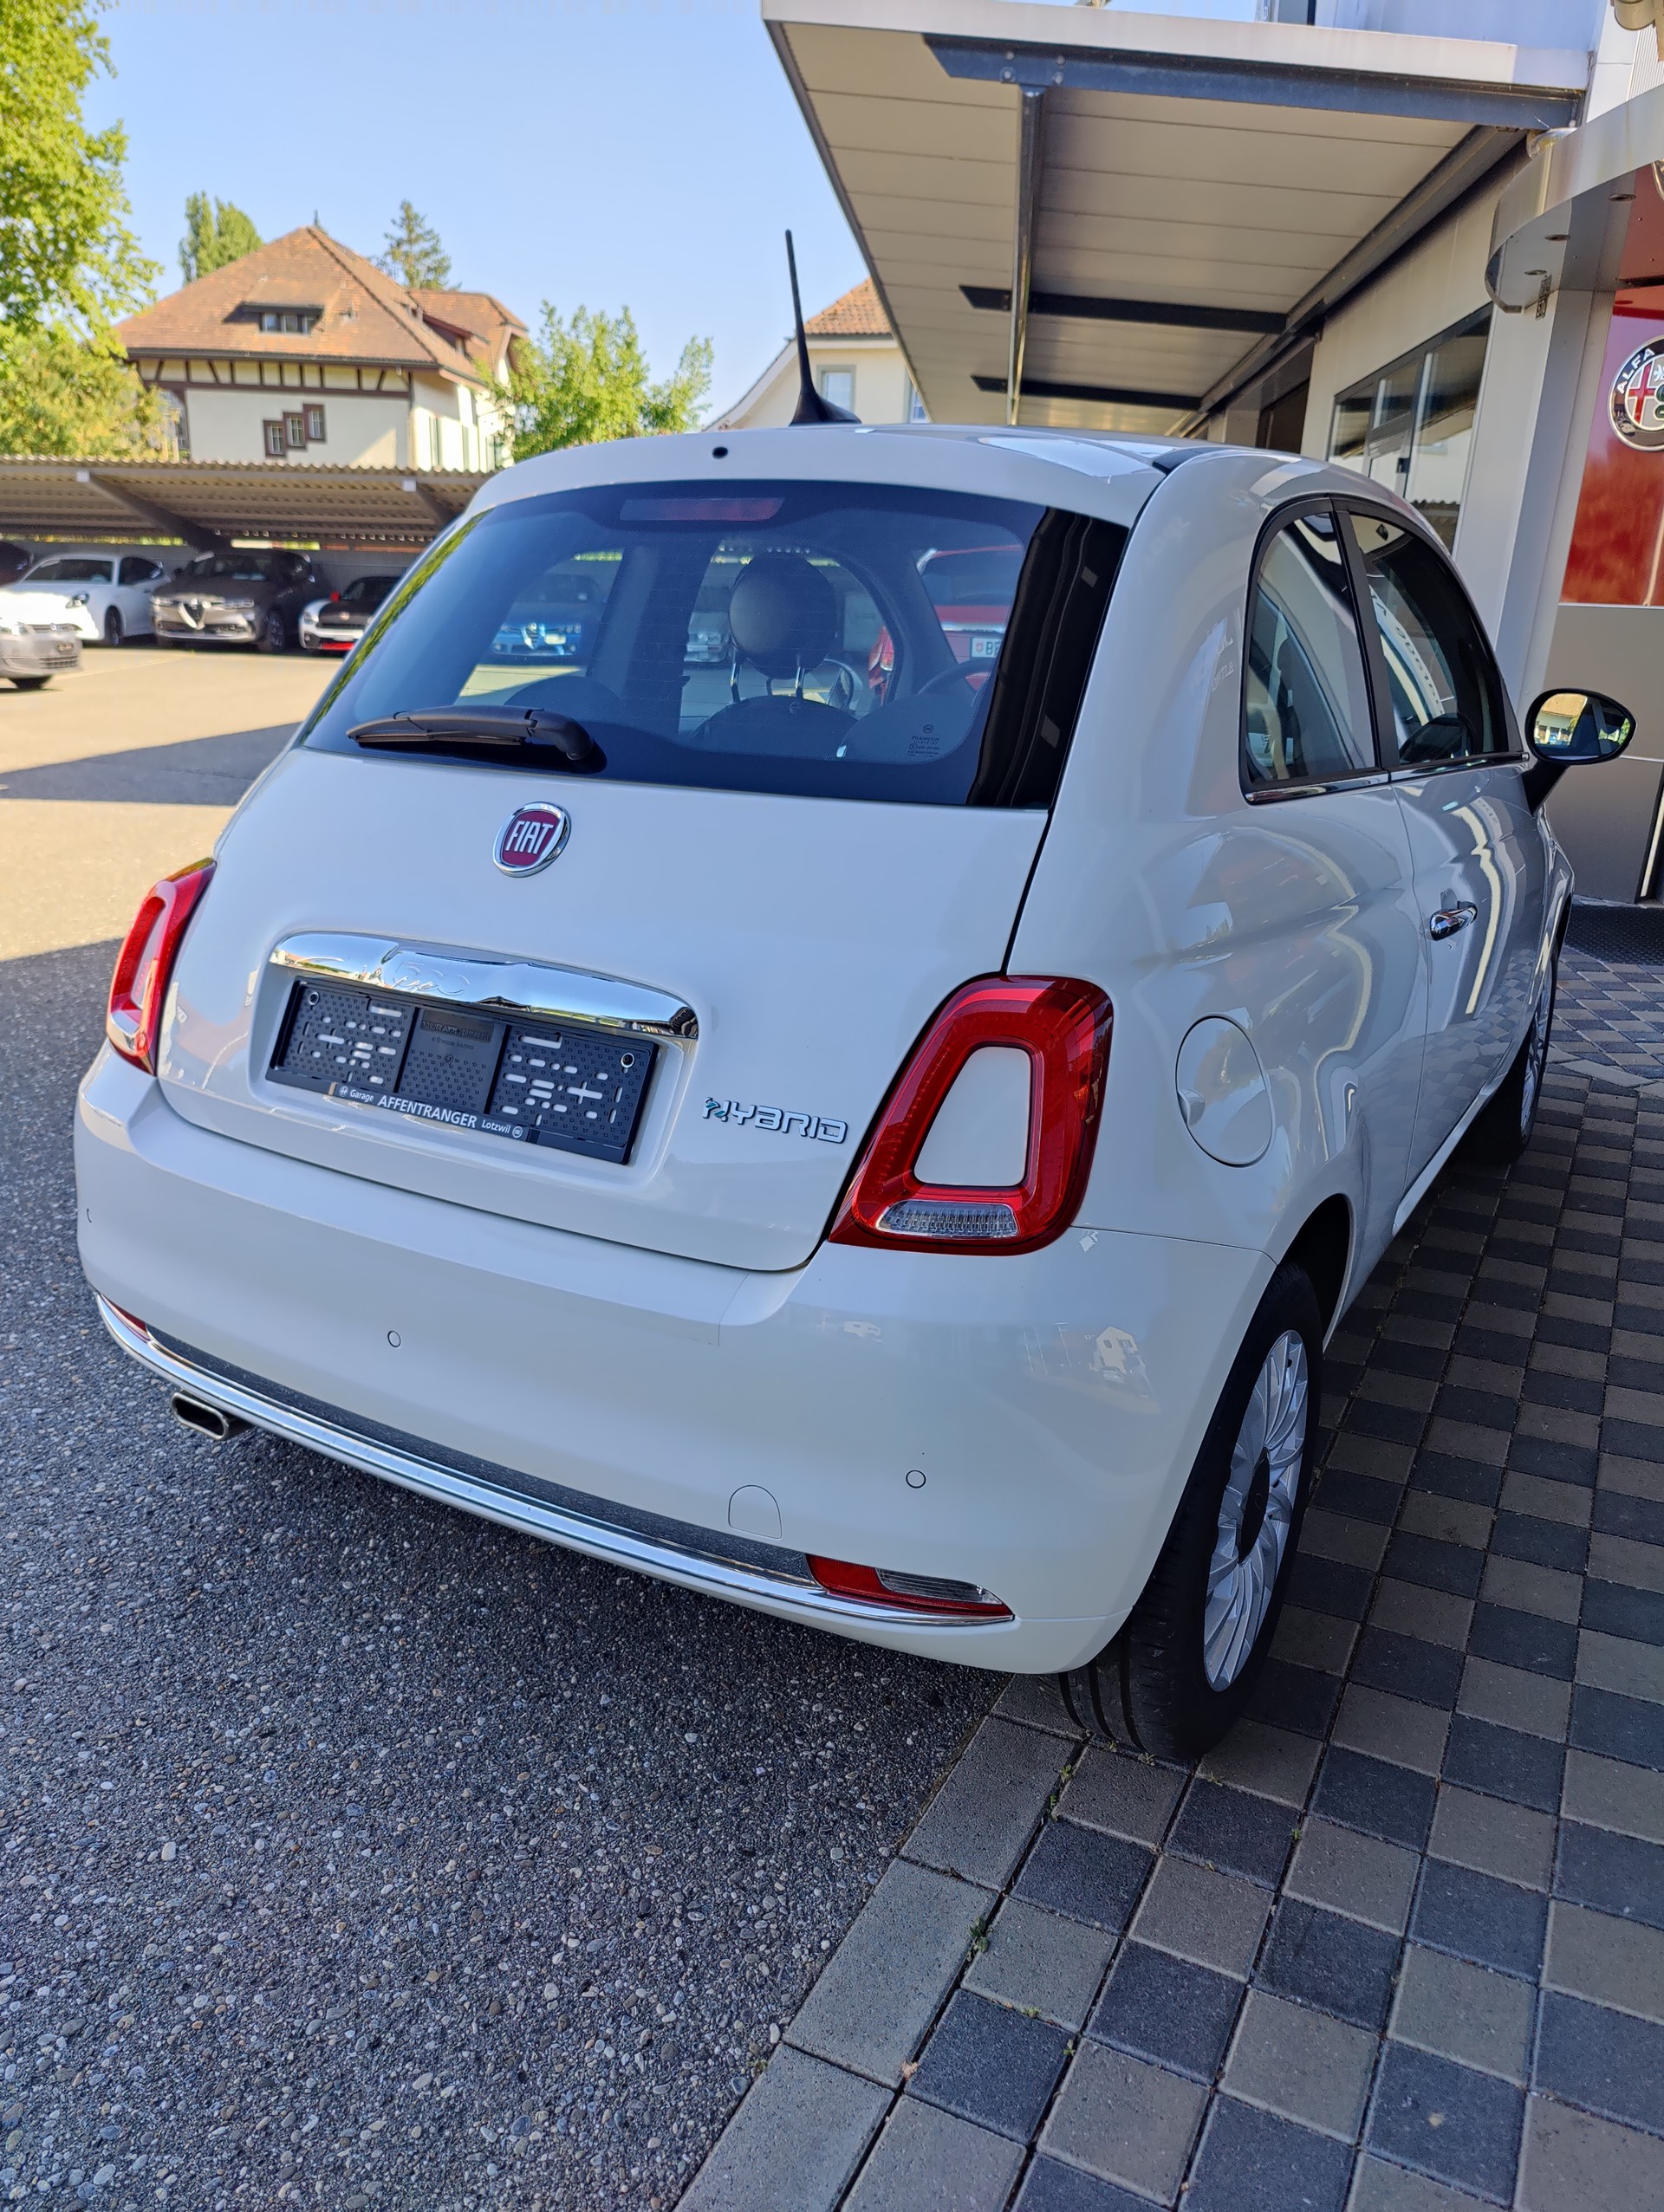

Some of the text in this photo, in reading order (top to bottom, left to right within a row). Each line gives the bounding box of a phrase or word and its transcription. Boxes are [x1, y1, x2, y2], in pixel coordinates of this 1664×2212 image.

[1616, 347, 1655, 394] ALFA
[505, 820, 555, 854] FIAT
[350, 1089, 374, 1102] Garage
[378, 1095, 478, 1128] AFFENTRANGER
[482, 1119, 510, 1134] Lotzwil
[702, 1096, 848, 1144] HYBRID
